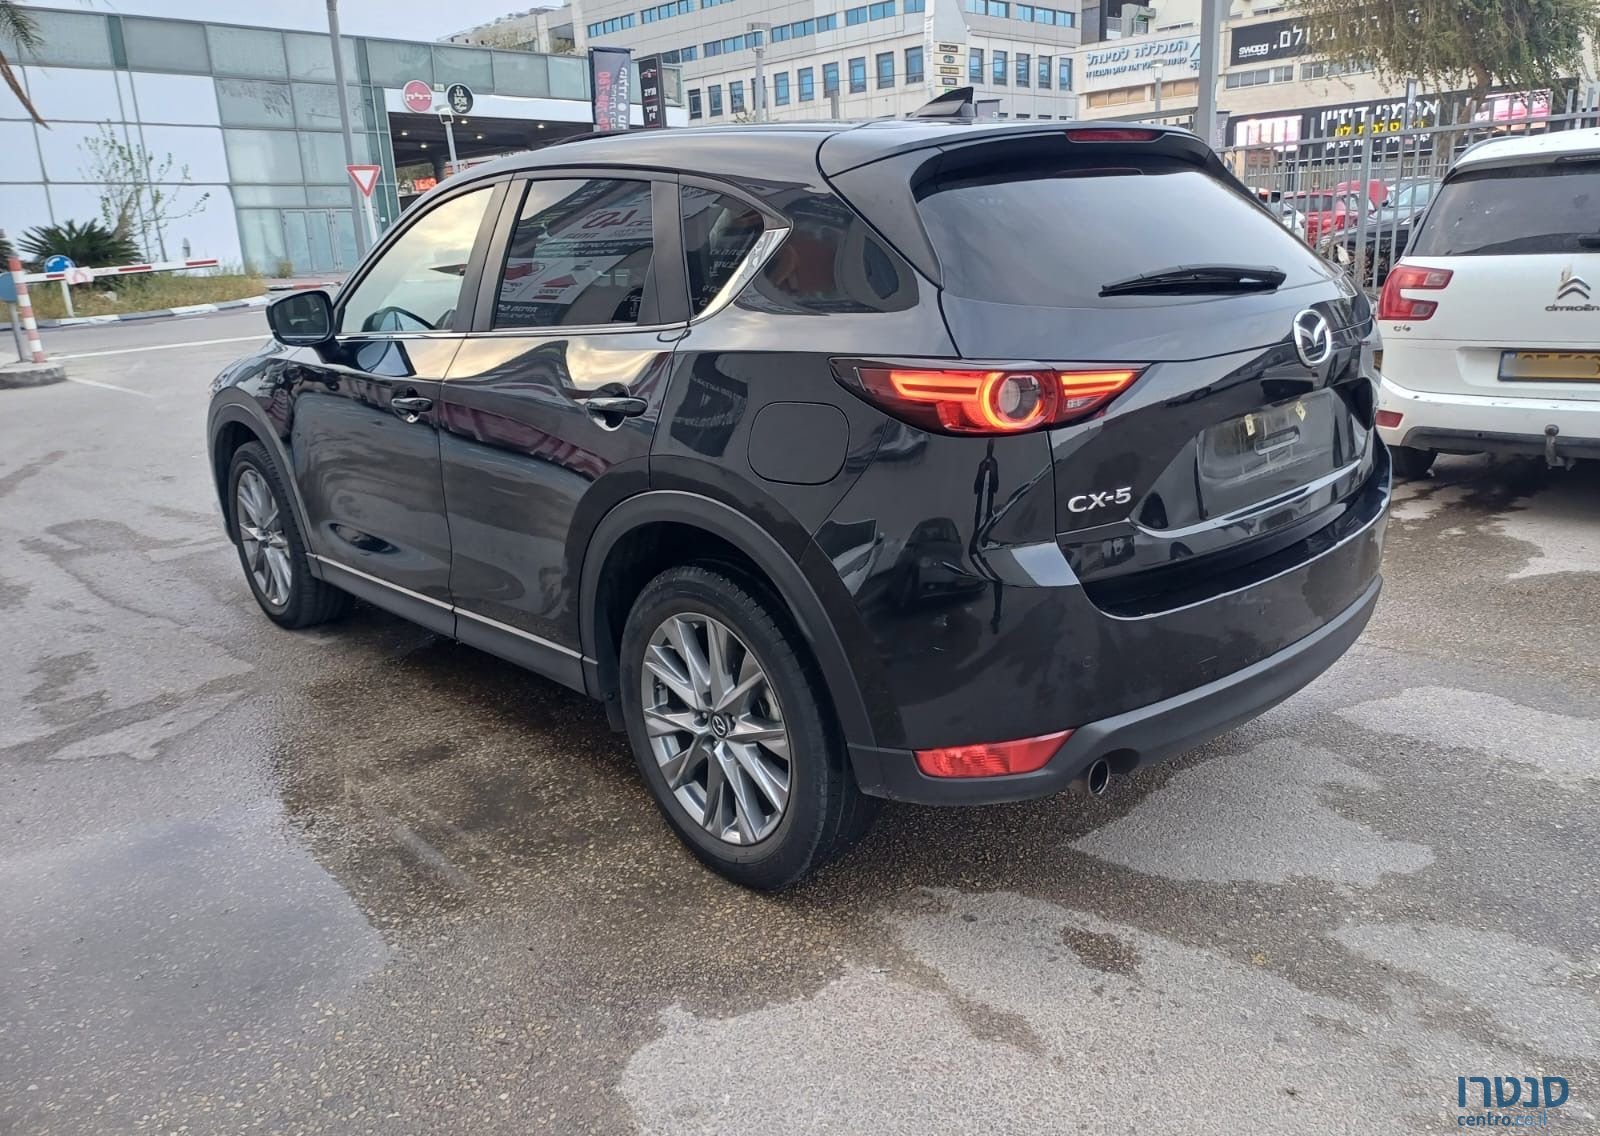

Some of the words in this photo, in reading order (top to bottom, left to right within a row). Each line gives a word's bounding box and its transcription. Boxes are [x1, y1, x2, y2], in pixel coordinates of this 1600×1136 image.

[1087, 47, 1130, 67] למינהל
[1135, 40, 1189, 59] המכללה
[1238, 43, 1269, 56] swagg
[1067, 486, 1132, 513] CX-5
